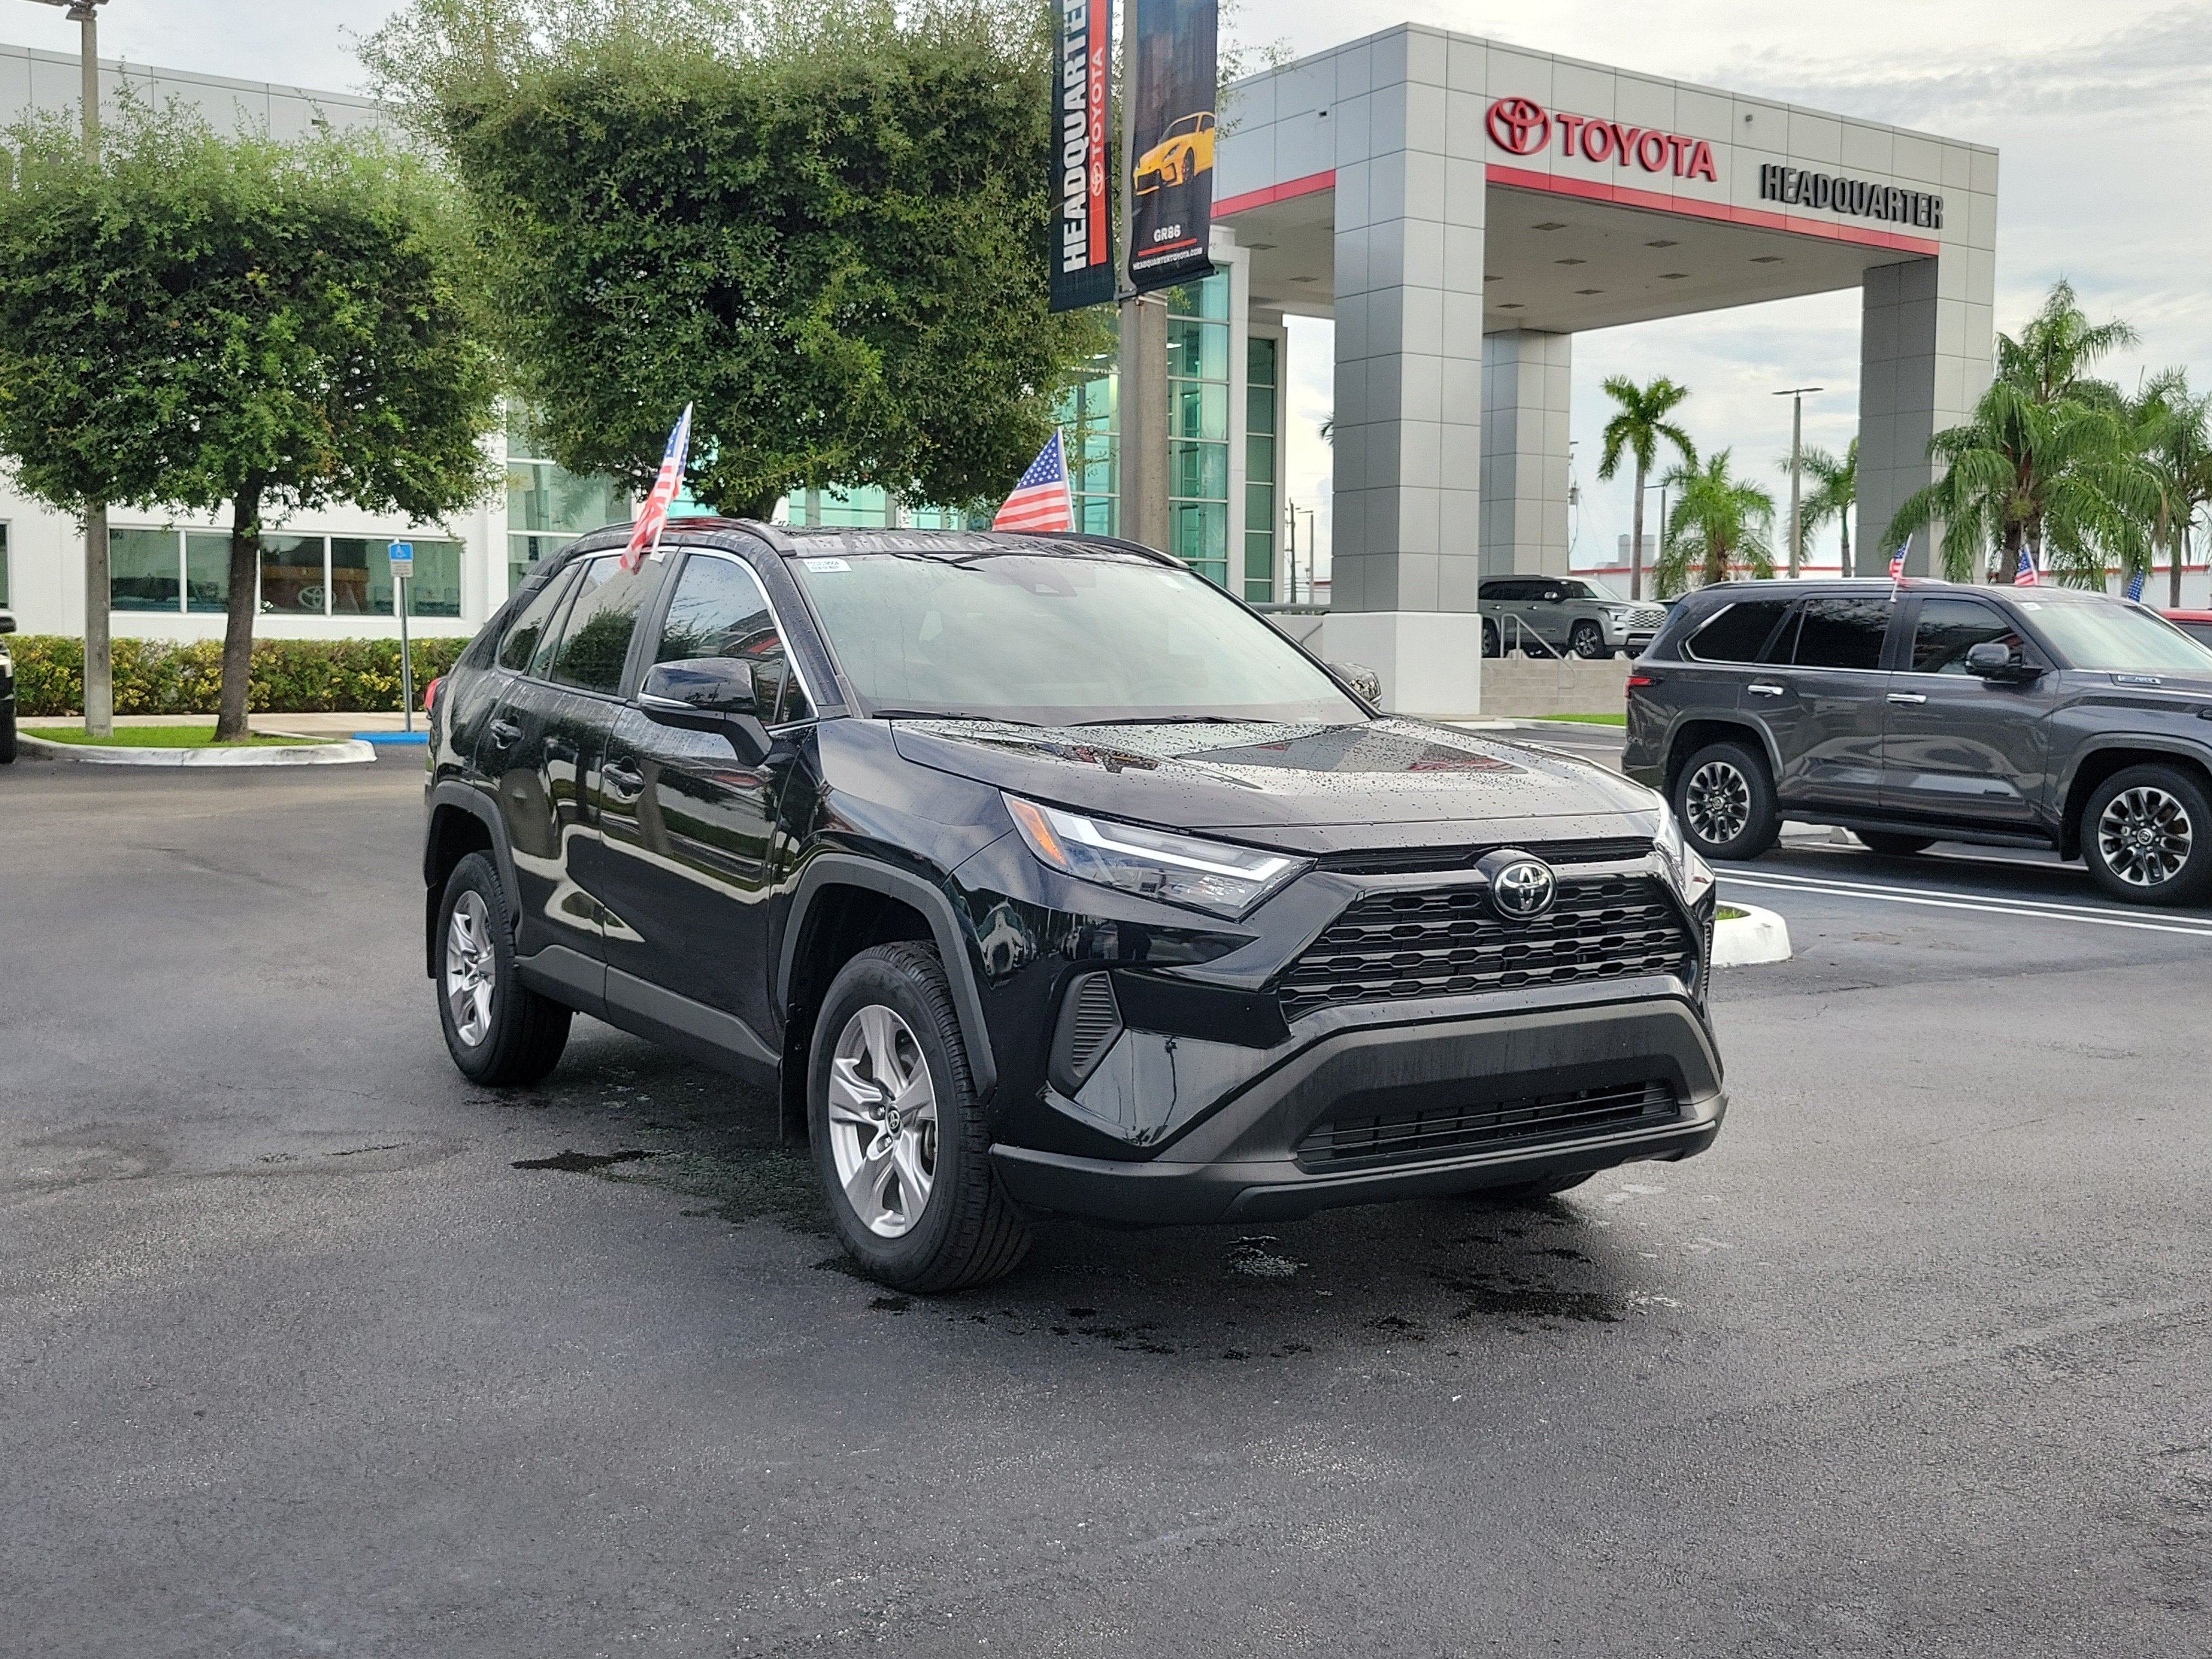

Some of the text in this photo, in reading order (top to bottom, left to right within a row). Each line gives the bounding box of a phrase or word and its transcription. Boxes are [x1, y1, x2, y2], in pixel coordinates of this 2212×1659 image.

[1092, 47, 1104, 160] TOYOTA
[1556, 113, 1718, 183] TOYOTA
[1760, 163, 1944, 229] HEADQUARTER
